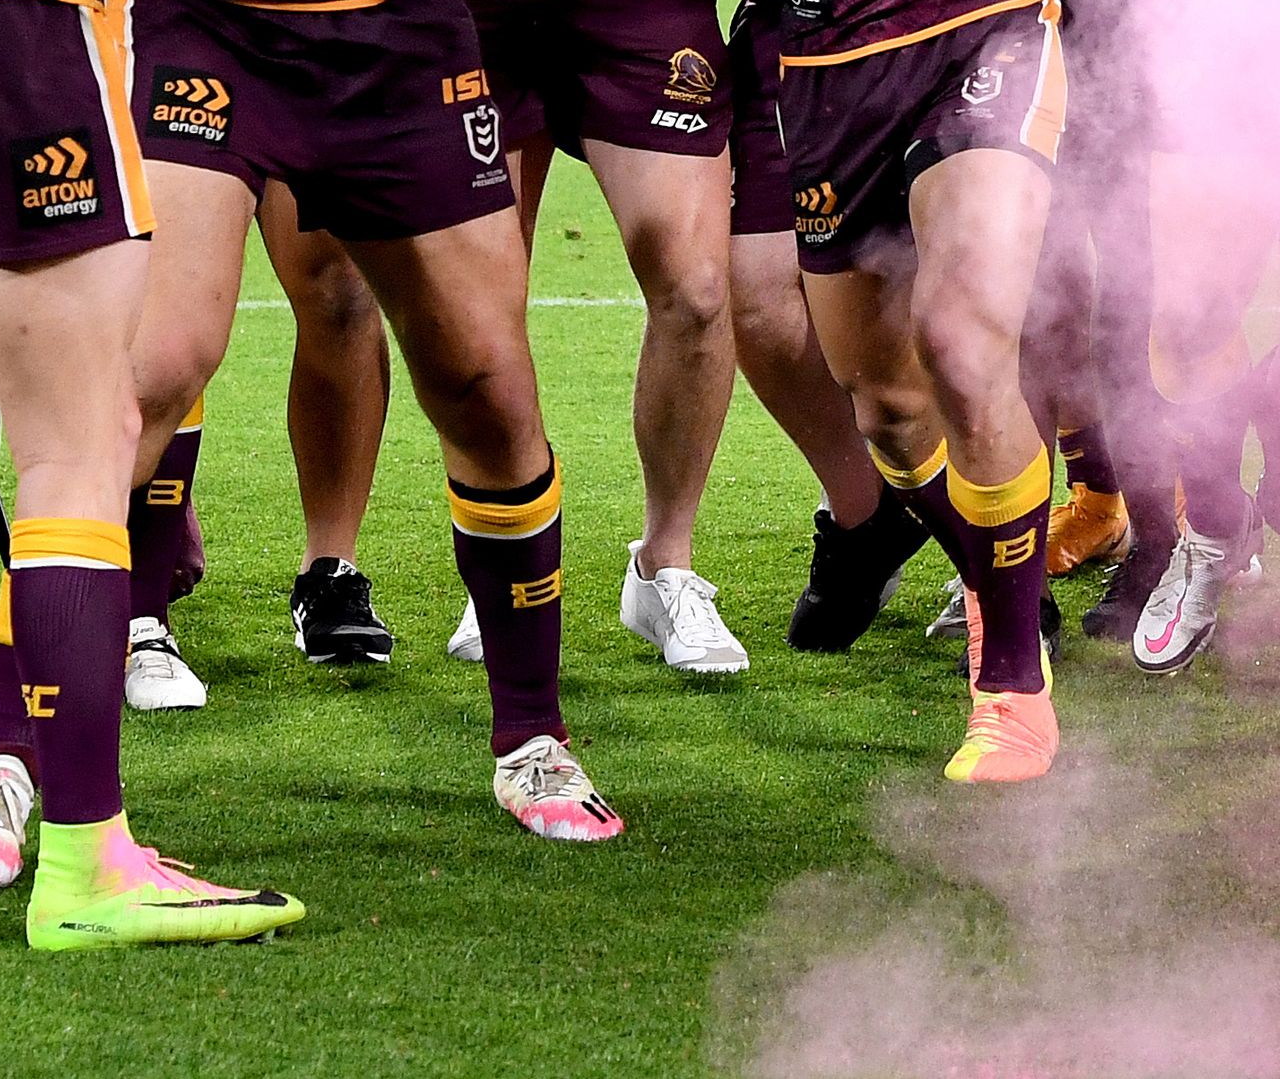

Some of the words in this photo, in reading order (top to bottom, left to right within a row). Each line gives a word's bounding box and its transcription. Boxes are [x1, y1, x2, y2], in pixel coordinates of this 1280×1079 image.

[152, 104, 228, 130] arrow
[650, 109, 694, 131] ISC
[168, 121, 225, 141] energy
[22, 178, 95, 209] arrow
[44, 195, 99, 218] energy
[795, 212, 844, 233] arrow
[146, 479, 185, 505] B
[993, 527, 1038, 568] B
[510, 568, 563, 609] B
